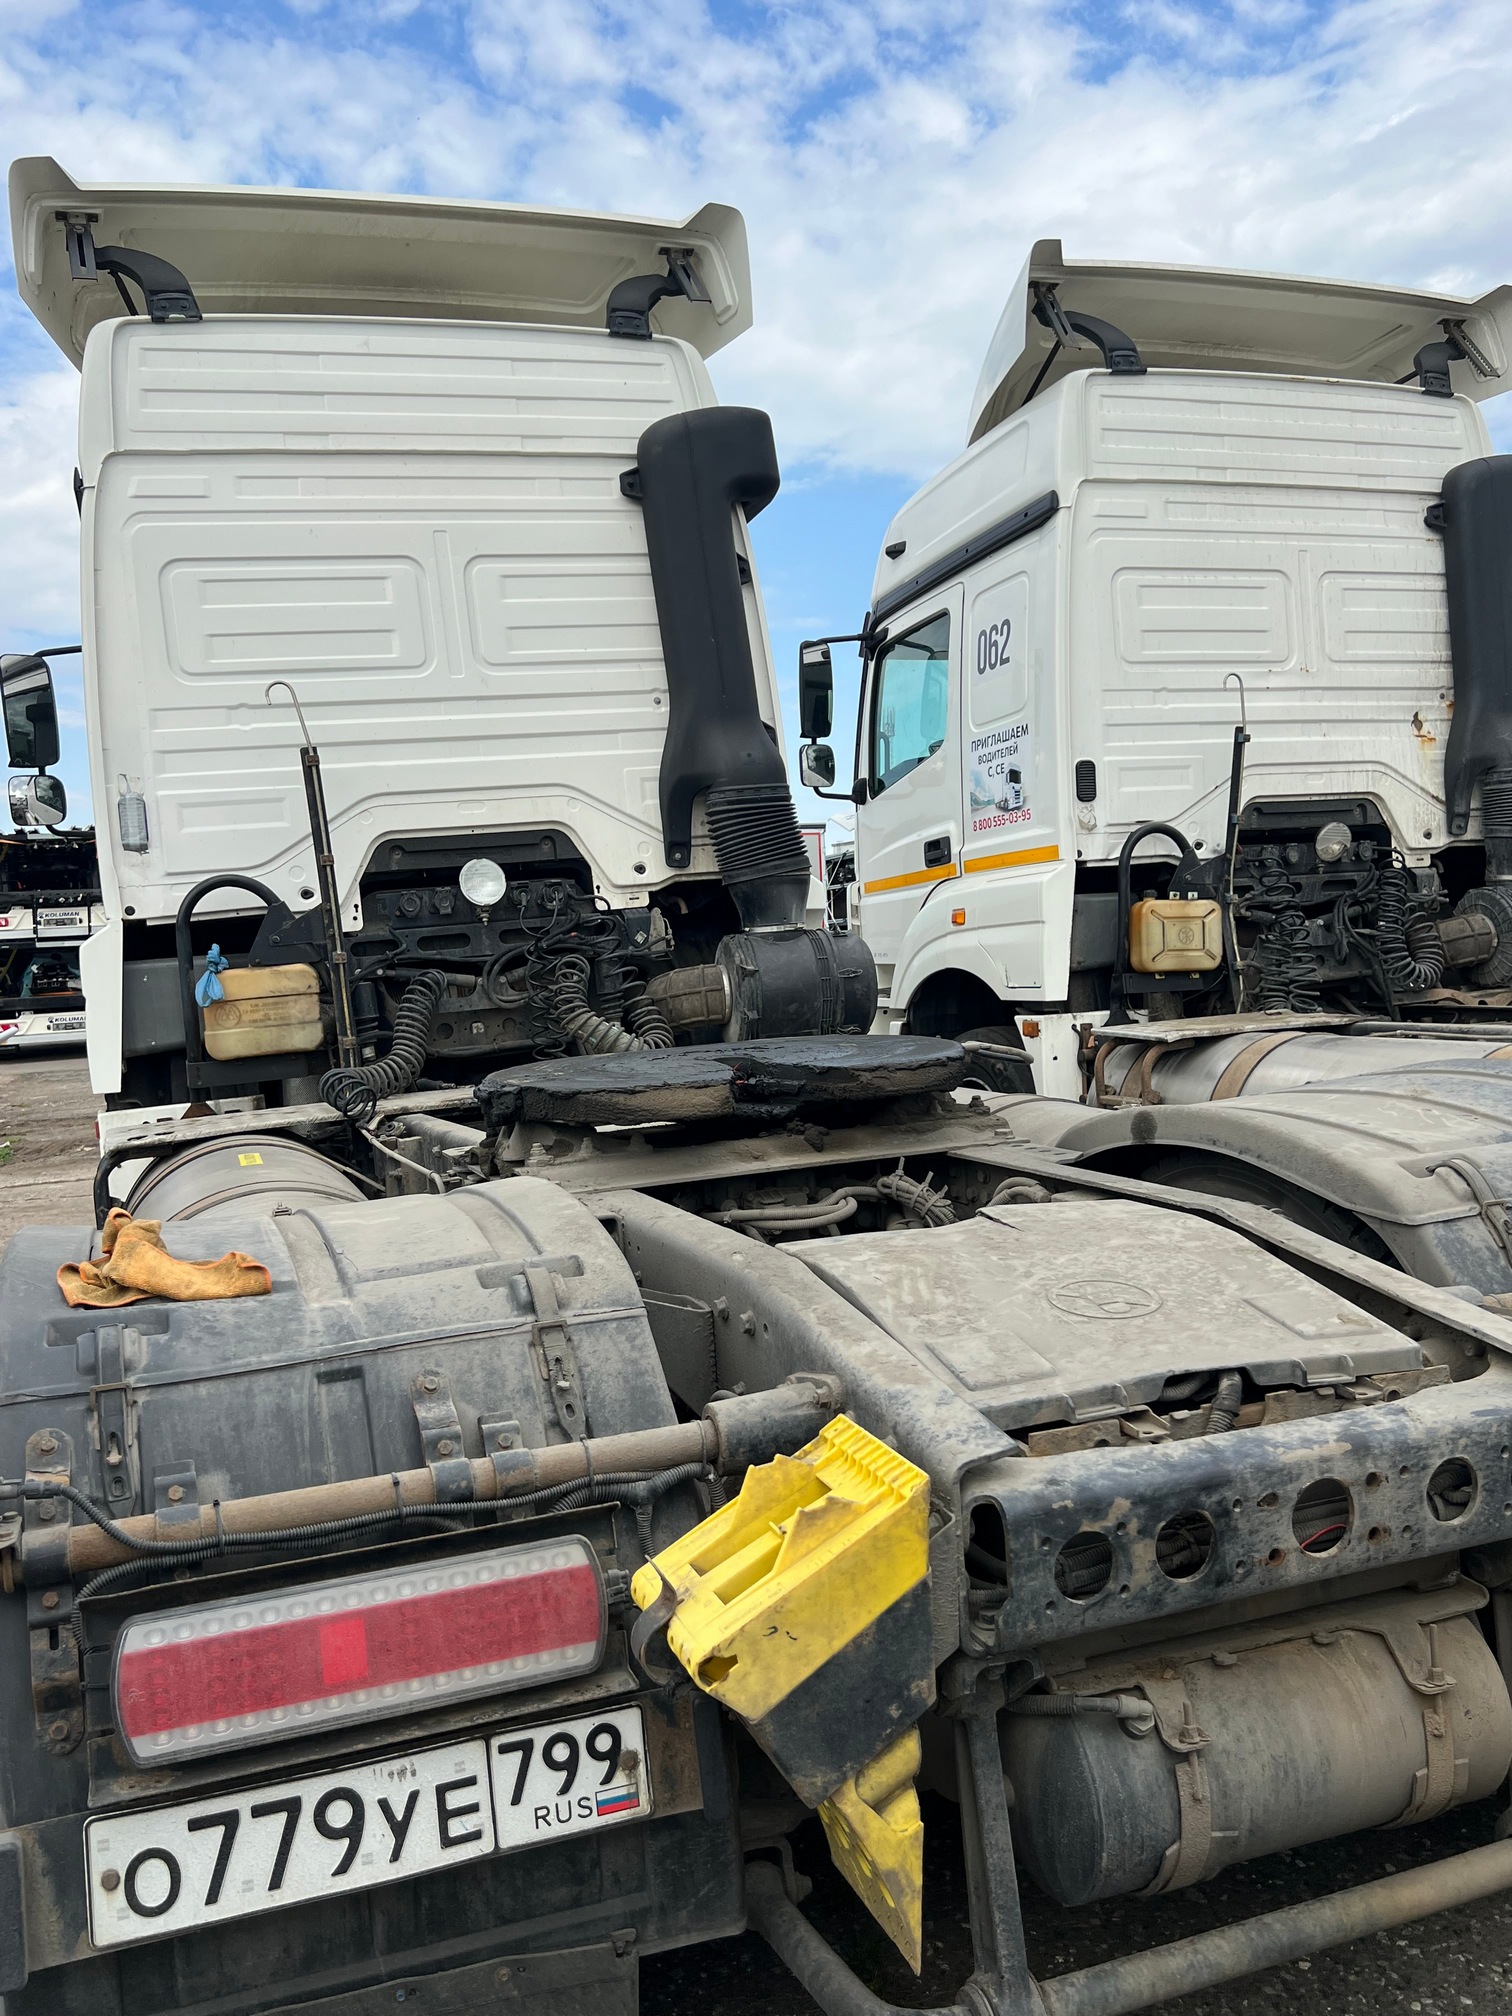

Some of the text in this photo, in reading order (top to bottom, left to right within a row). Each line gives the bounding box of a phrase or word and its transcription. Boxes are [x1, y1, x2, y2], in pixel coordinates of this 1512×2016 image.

[977, 618, 1011, 675] 062
[971, 723, 1029, 753] ПРИГЛАШАЕМ
[978, 741, 1018, 765] ВОДИТЕЛЕЙ
[972, 808, 1031, 832] 8 800 555-03-95
[498, 1722, 622, 1807] 799
[533, 1795, 594, 1830] RUS
